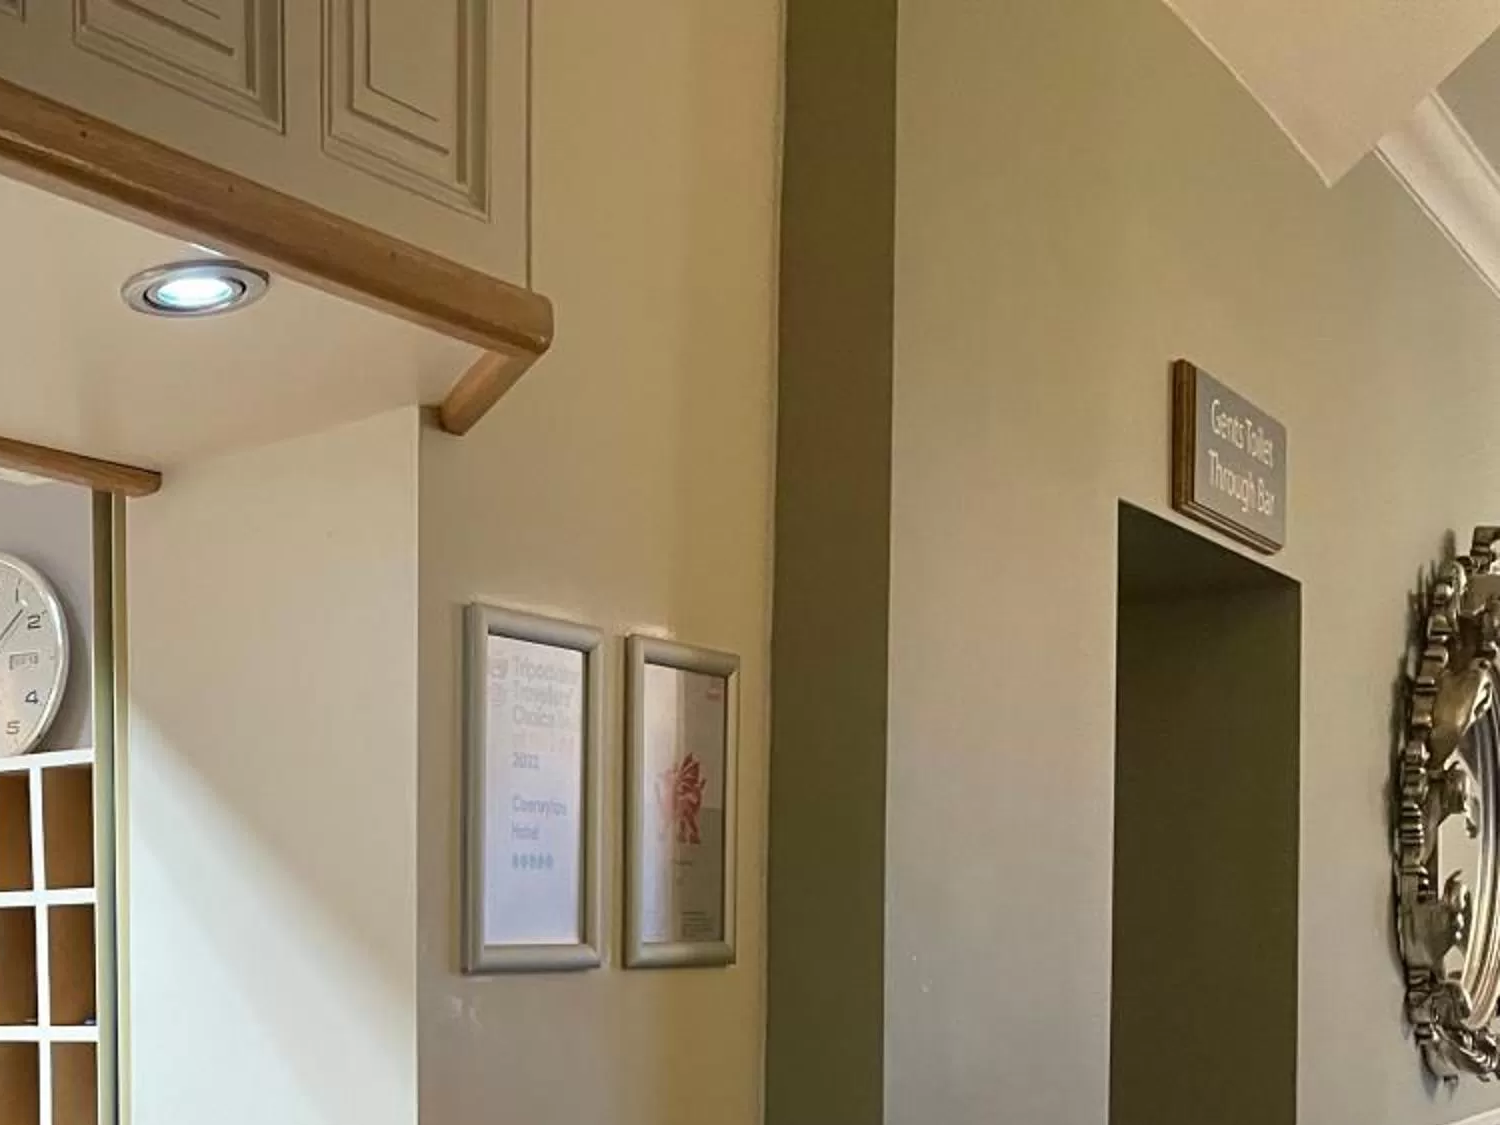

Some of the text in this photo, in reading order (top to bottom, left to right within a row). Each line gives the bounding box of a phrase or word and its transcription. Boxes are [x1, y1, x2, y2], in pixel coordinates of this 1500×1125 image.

[1210, 399, 1244, 450] Gents
[1208, 448, 1276, 516] Through Bar
[27, 615, 41, 630] 2
[24, 690, 39, 705] 4
[6, 720, 21, 736] 5
